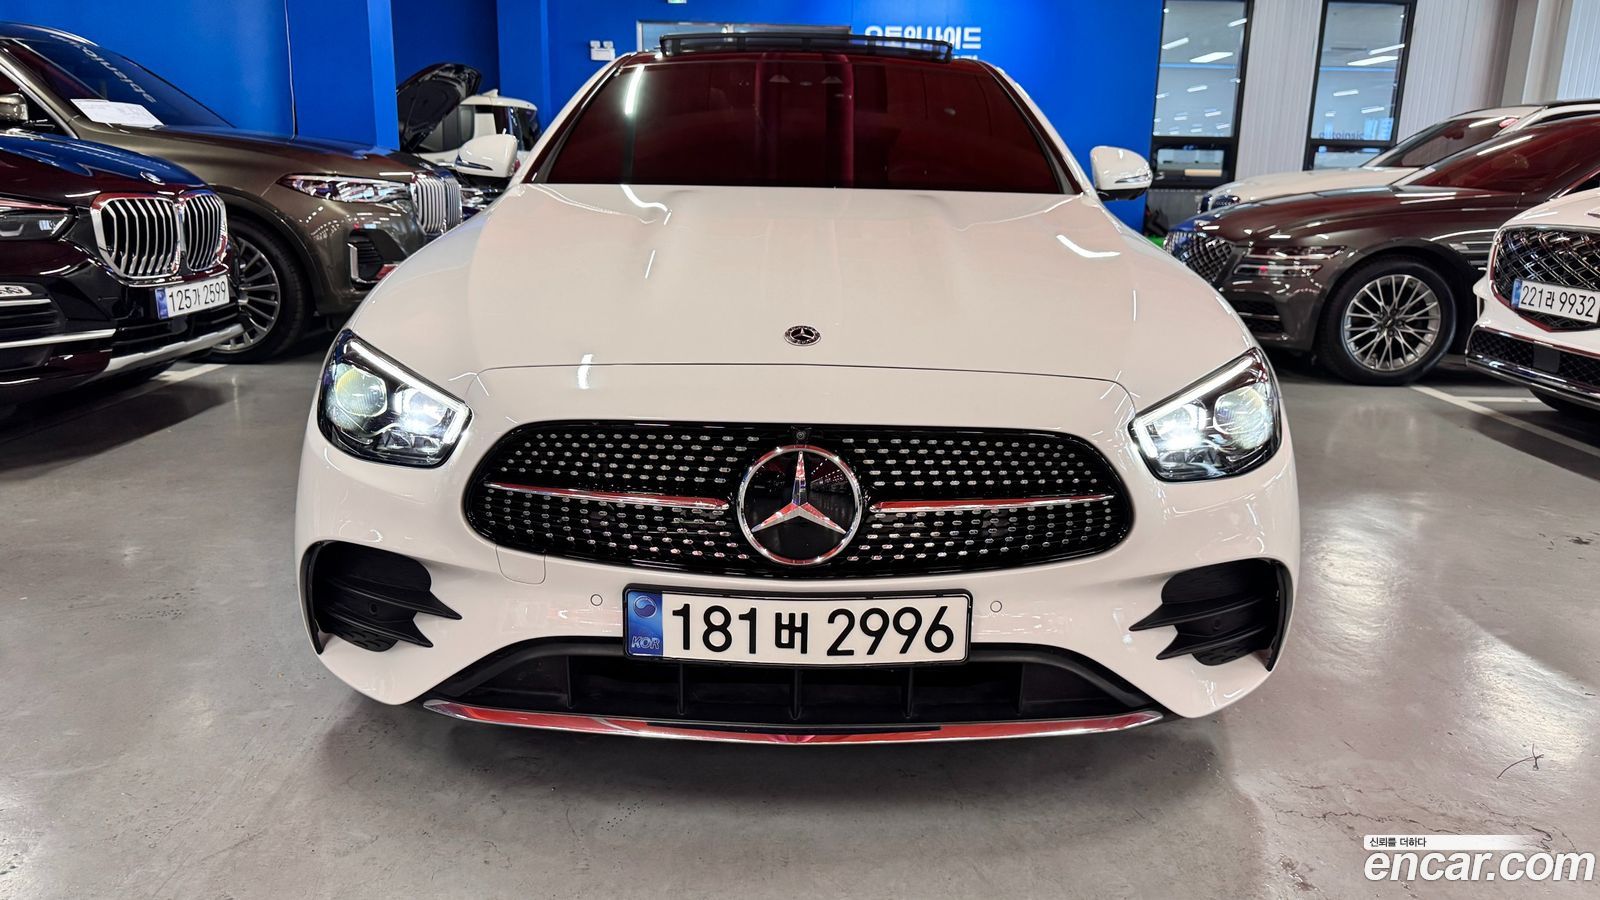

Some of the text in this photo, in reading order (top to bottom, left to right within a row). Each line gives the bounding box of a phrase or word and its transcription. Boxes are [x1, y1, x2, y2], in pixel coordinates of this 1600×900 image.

[203, 281, 227, 305] 2599
[1559, 291, 1596, 318] 9932
[631, 635, 661, 650] KOR
[826, 605, 954, 656] 2996
